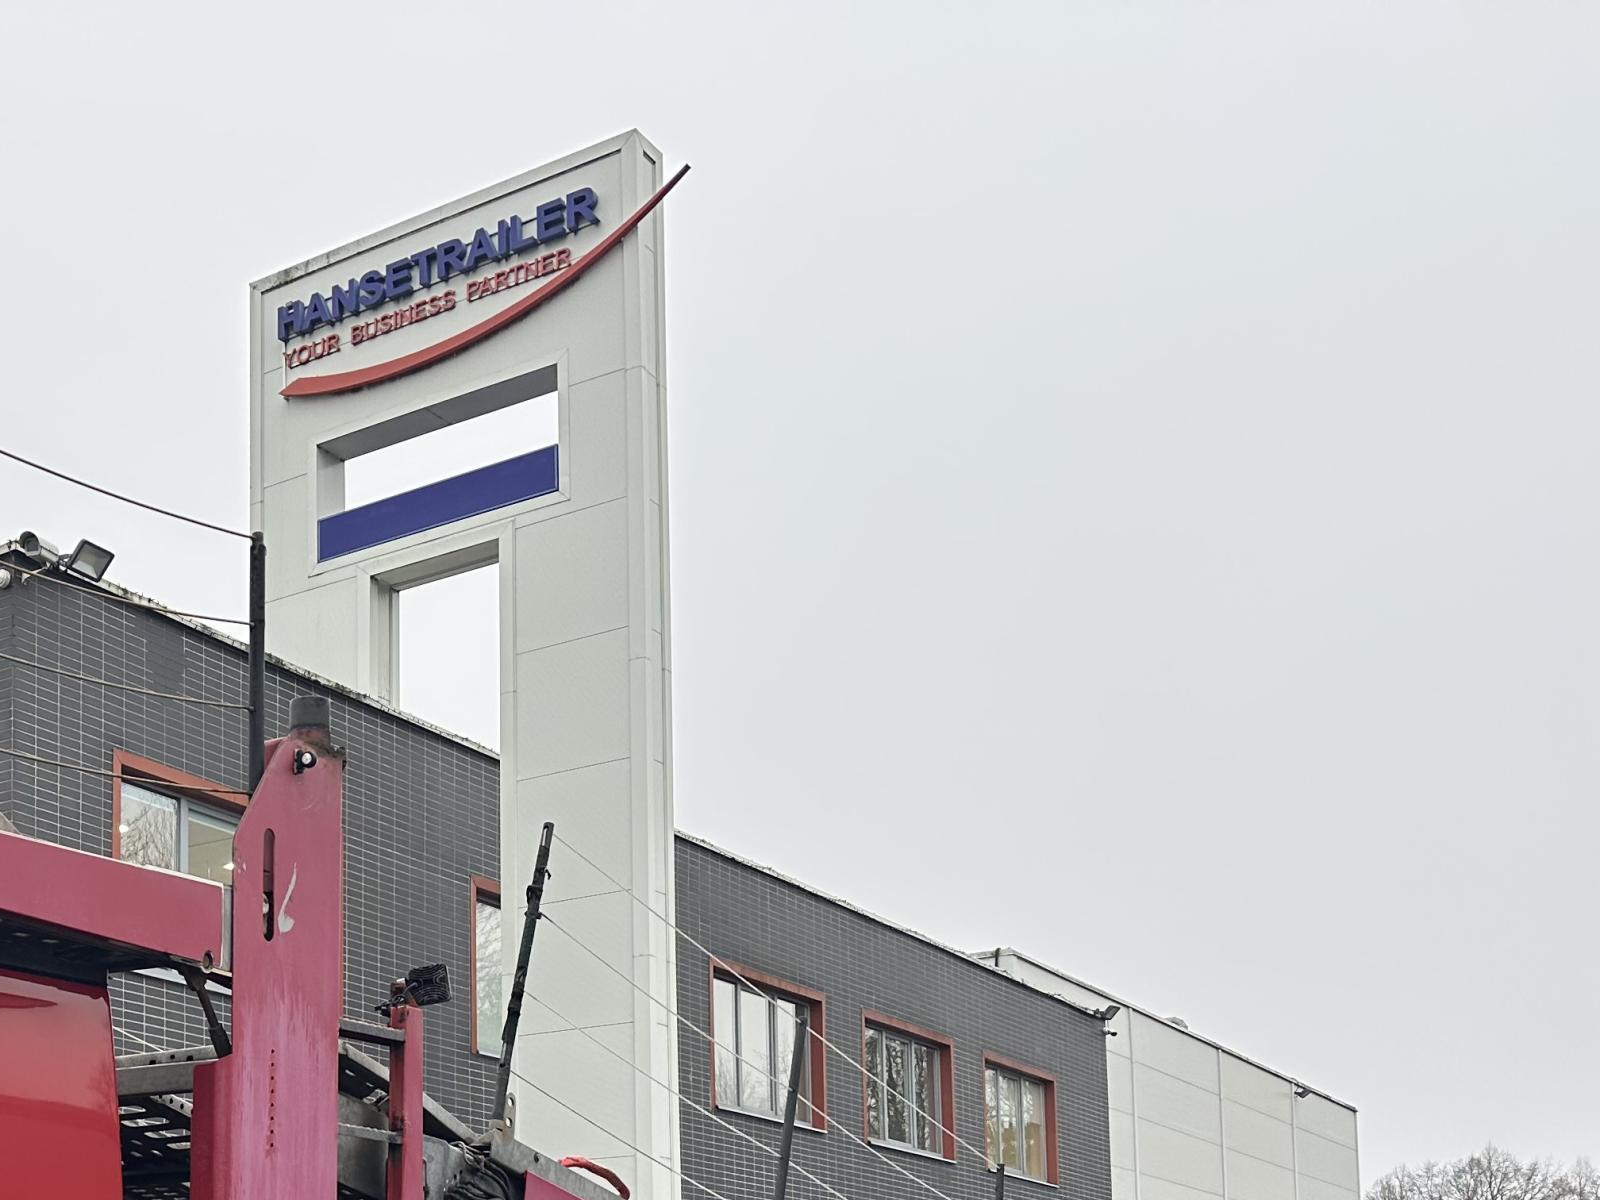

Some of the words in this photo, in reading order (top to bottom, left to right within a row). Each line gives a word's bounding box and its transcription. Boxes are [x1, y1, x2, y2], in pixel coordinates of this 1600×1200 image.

[278, 187, 600, 343] HANSETRAILER
[282, 333, 341, 370] YOUR
[350, 289, 456, 346] BUSINESS
[466, 246, 572, 303] PARTNER
